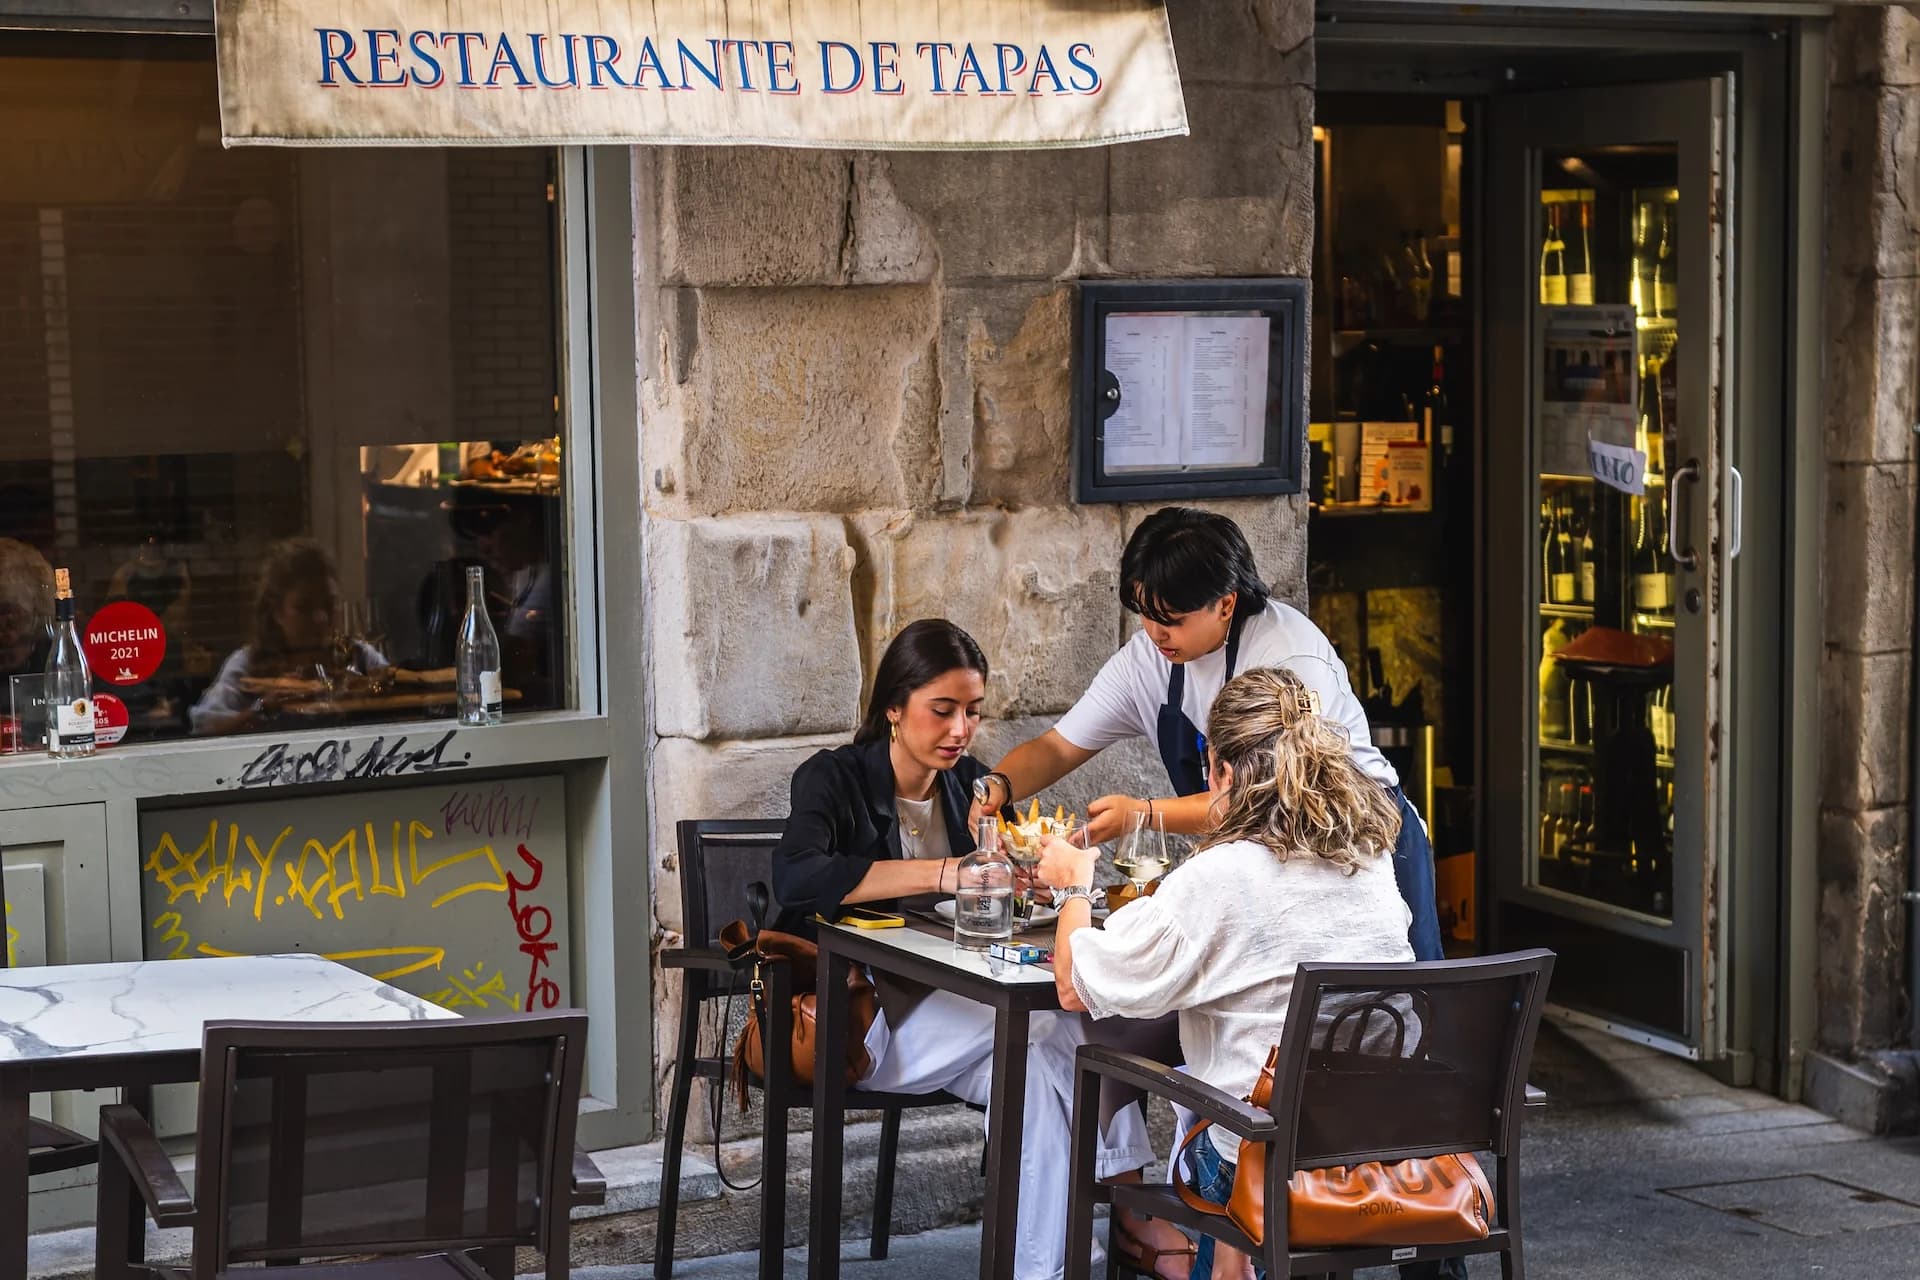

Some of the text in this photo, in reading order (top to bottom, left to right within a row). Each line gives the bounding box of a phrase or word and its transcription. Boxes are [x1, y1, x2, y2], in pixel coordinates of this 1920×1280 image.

[313, 28, 1102, 96] RESTAURANTE DE TAPAS
[90, 627, 158, 645] MICHELIN
[110, 647, 140, 660] 2021
[1358, 1201, 1405, 1217] ROMA
